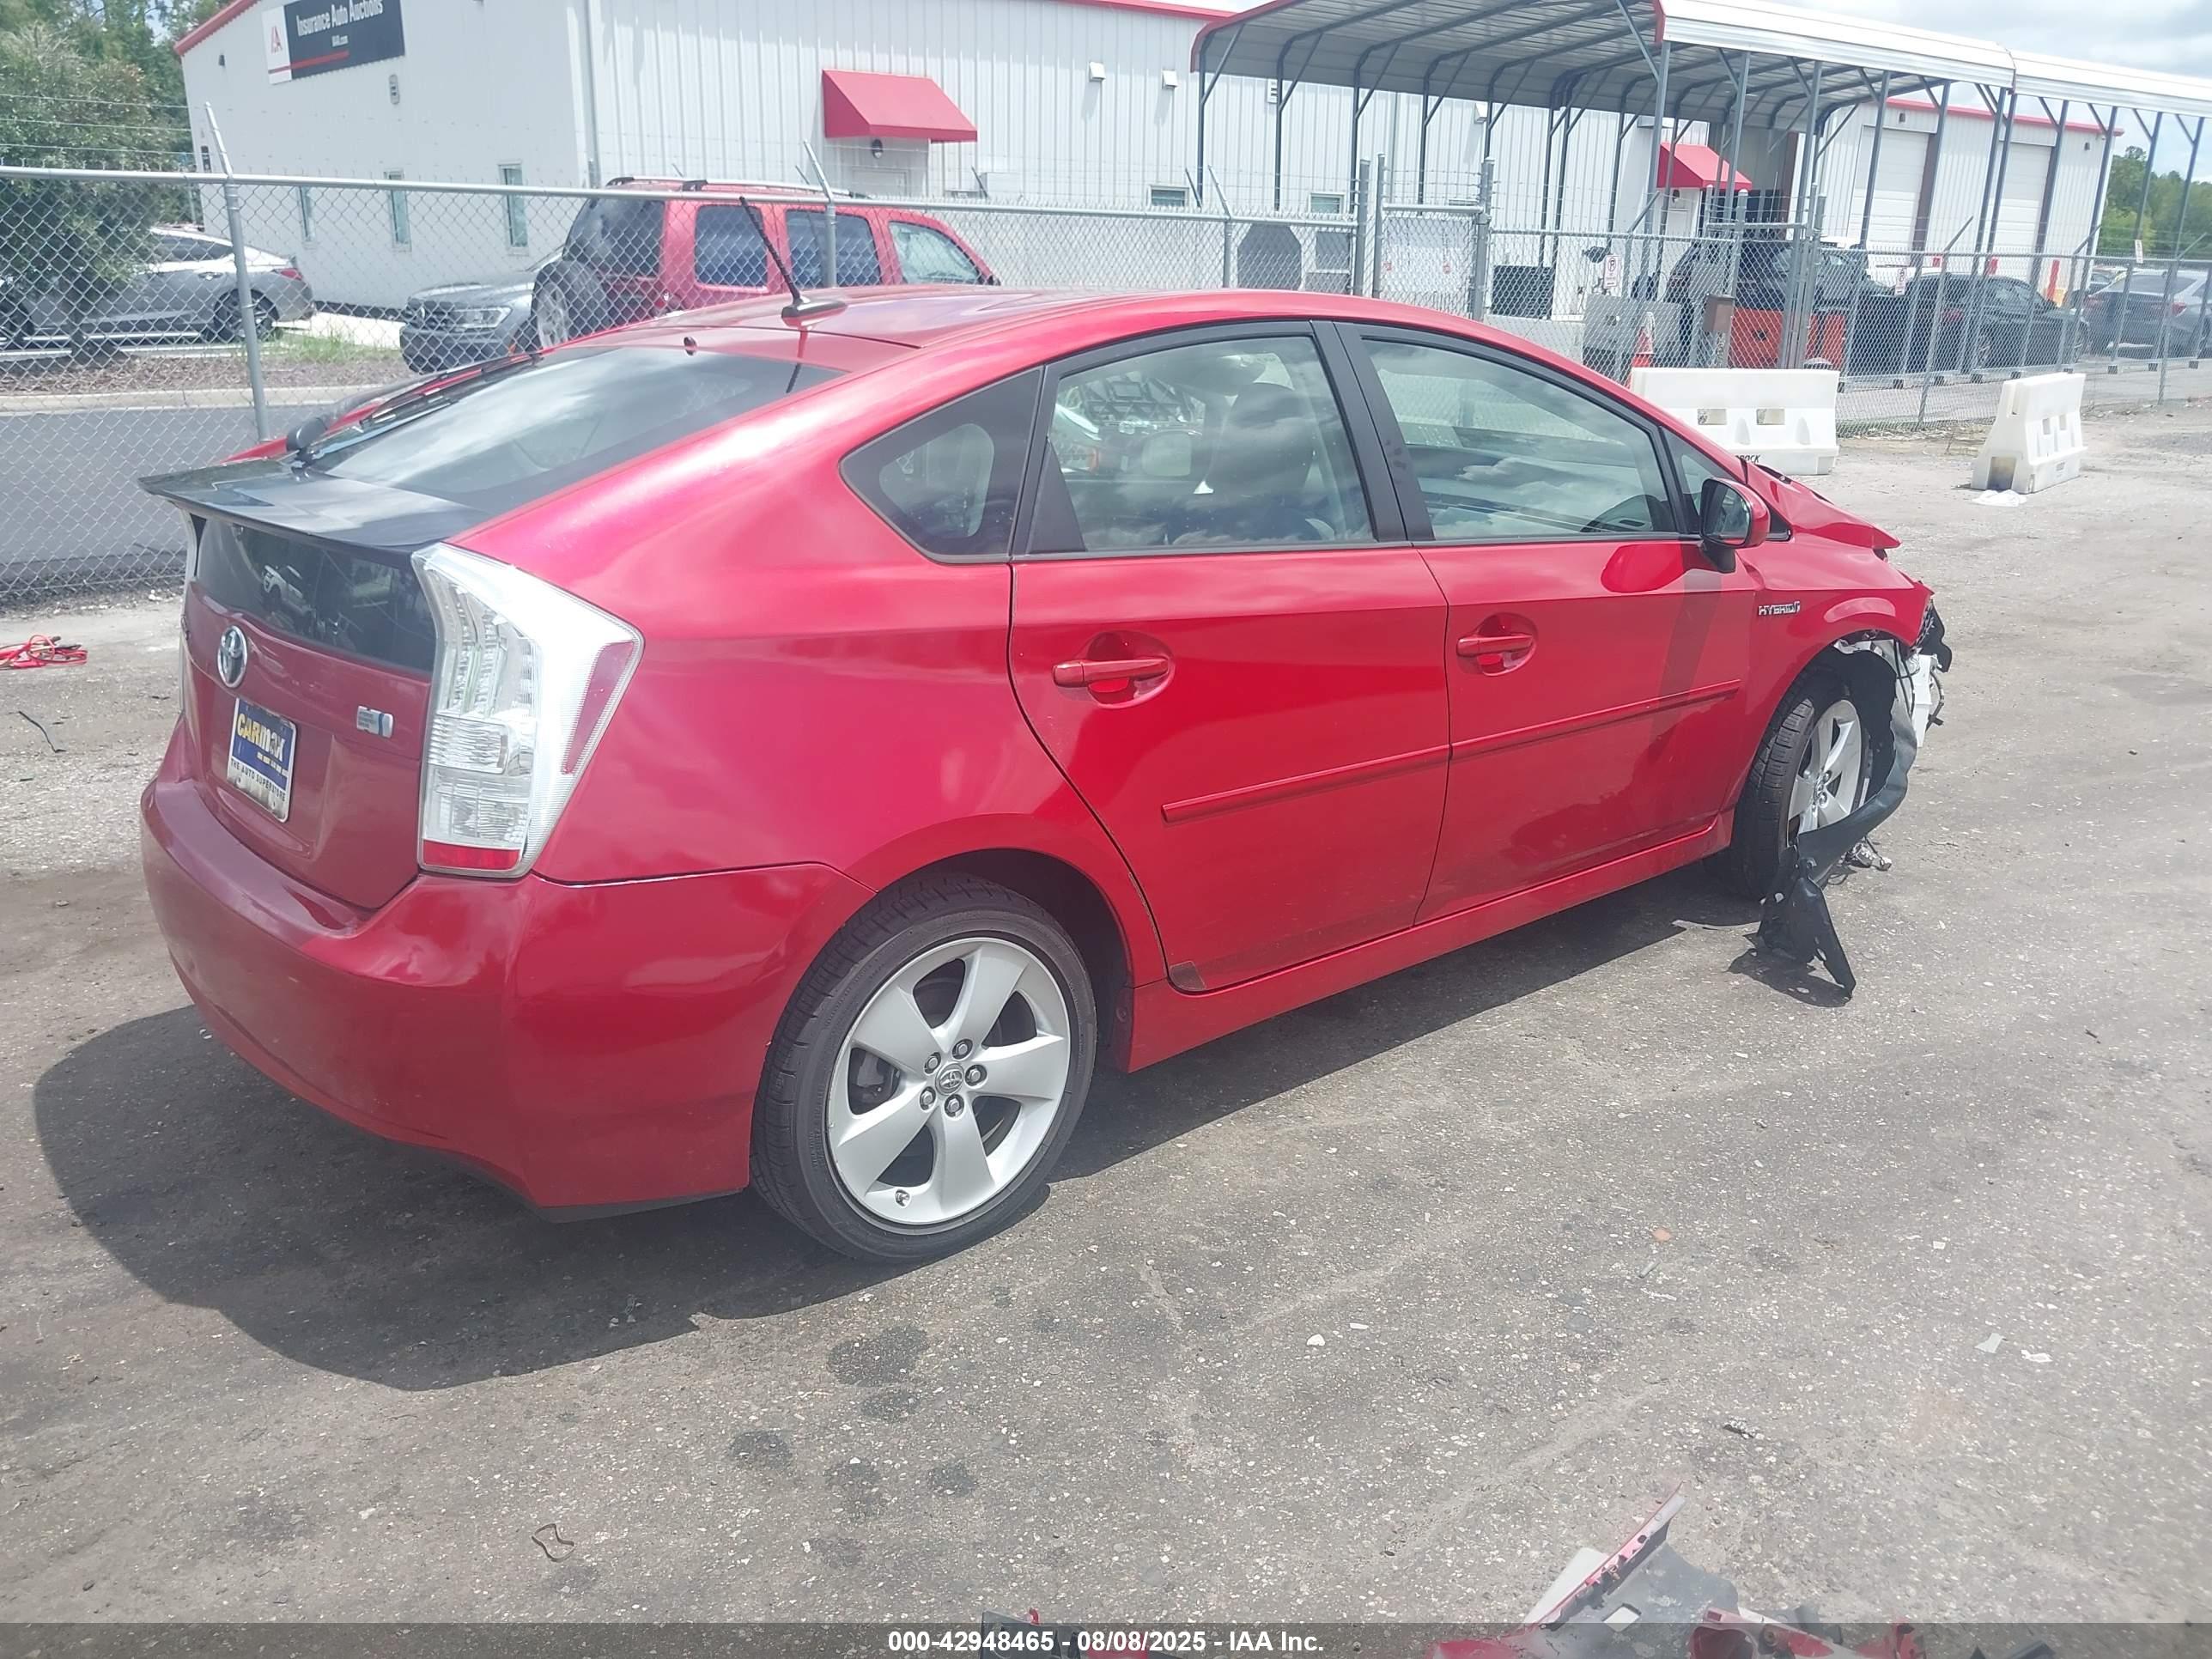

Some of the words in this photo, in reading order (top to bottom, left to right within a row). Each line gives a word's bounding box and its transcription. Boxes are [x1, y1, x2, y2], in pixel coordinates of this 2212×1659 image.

[296, 12, 331, 36] Insurance
[331, 4, 349, 27] Auto
[349, 0, 383, 22] Auctions
[231, 757, 240, 770] THE
[241, 764, 255, 780] AUTO
[256, 774, 286, 802] SUPERSTORE
